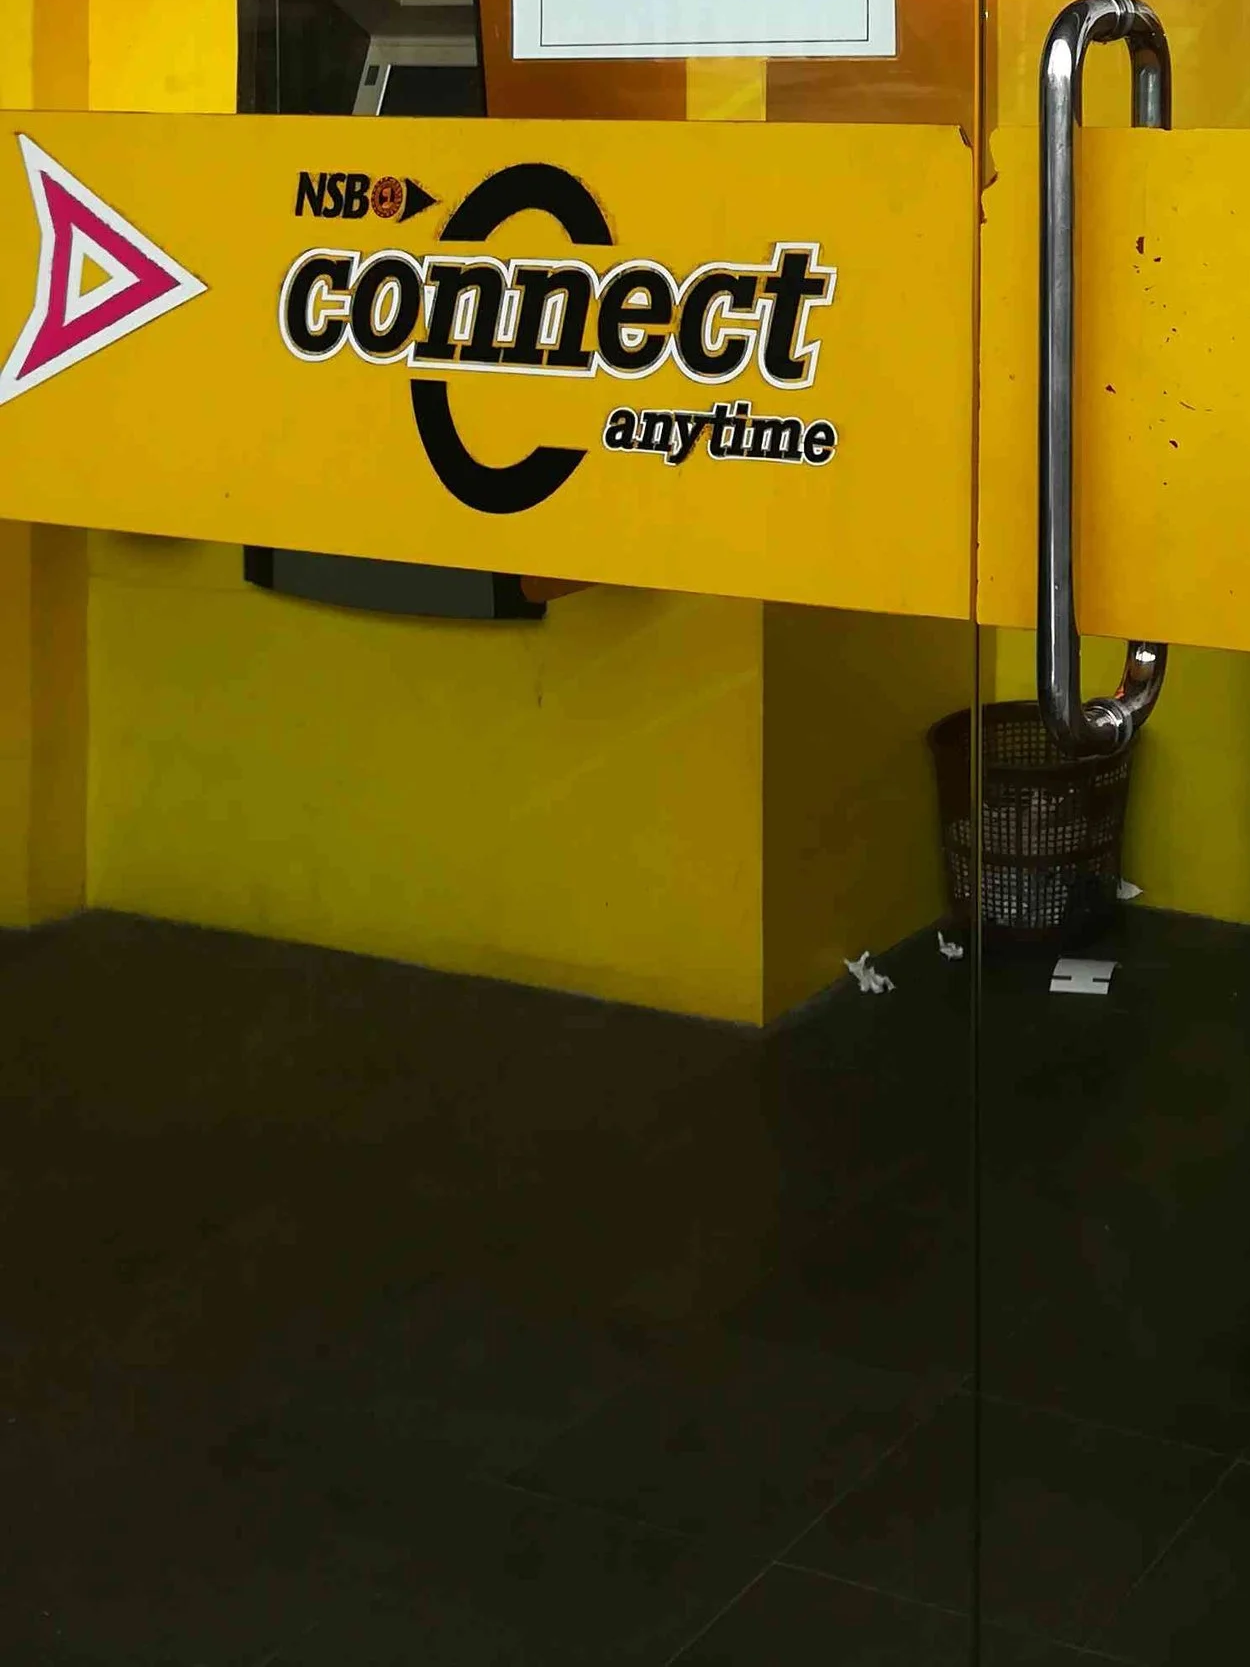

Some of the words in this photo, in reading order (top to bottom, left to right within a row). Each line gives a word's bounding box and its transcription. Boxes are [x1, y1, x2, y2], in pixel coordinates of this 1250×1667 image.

[295, 171, 370, 221] NSB
[280, 243, 837, 390] connect
[603, 400, 839, 466] anytime
